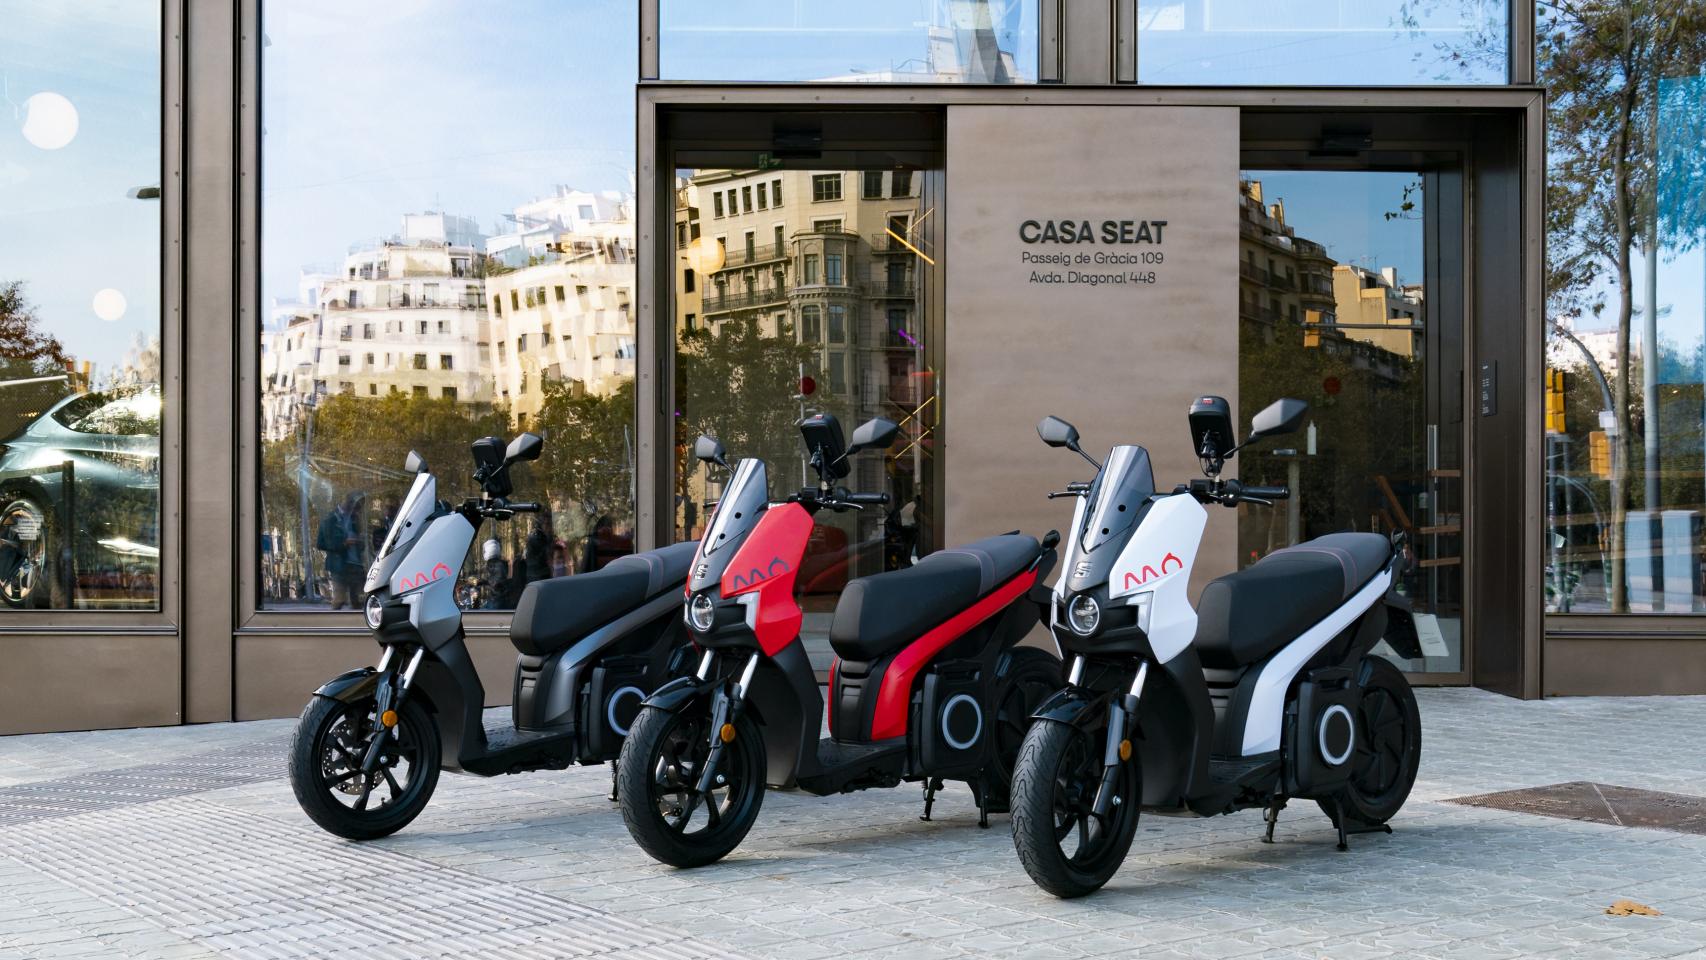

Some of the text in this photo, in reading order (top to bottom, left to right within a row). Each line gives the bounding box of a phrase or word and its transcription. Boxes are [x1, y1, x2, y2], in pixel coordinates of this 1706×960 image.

[1019, 220, 1168, 244] CASA SEAT
[1022, 251, 1164, 266] Passeig de Gràcia 109
[1029, 271, 1156, 286] Avda. Diagonal 448
